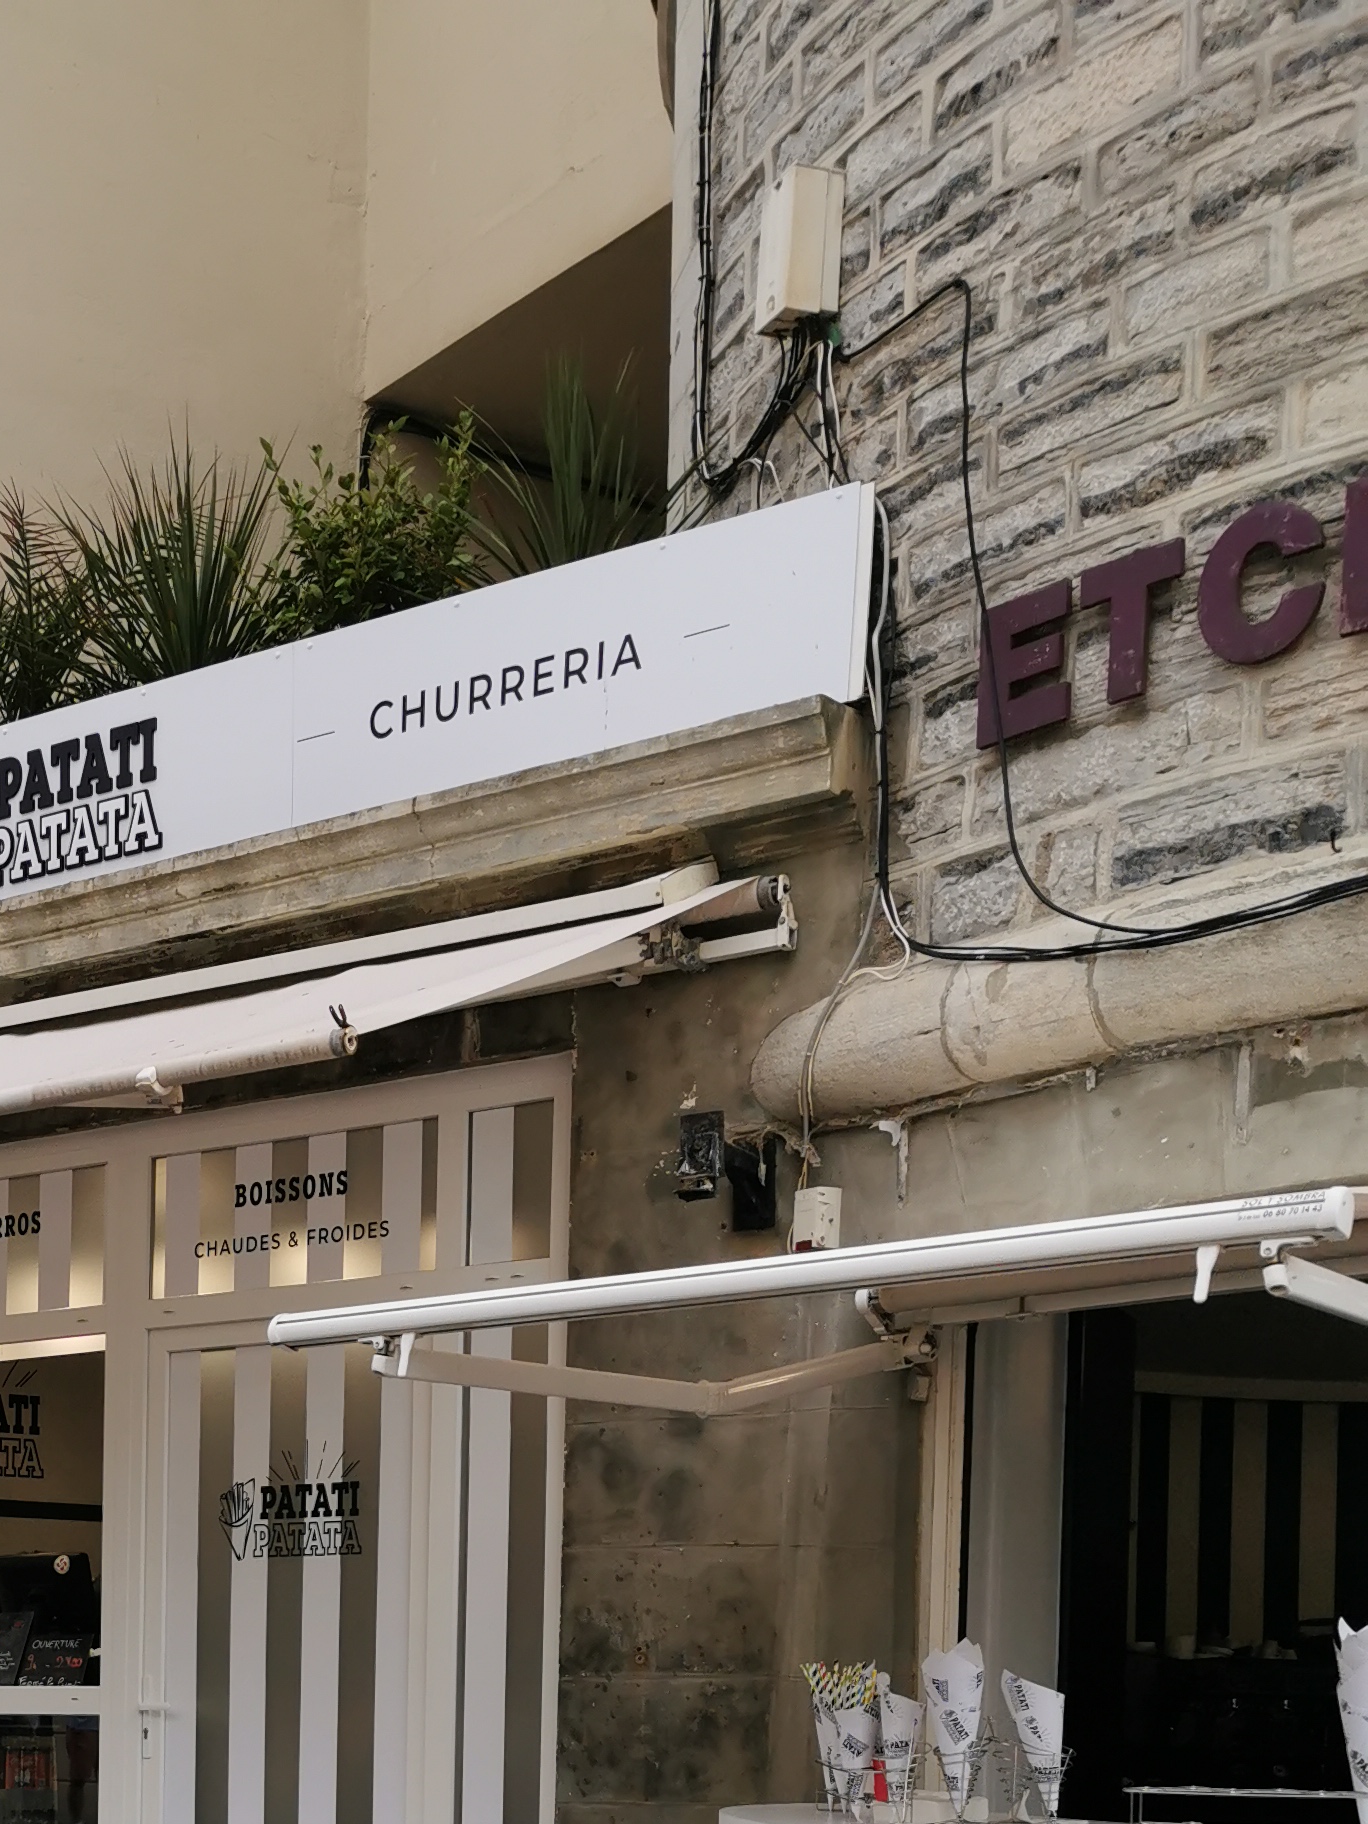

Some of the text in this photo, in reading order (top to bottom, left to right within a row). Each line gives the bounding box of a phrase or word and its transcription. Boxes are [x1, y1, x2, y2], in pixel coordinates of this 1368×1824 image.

[368, 633, 643, 740] CHURRERIA
[234, 1170, 348, 1208] BOISSONS
[194, 1220, 390, 1259] CHAUDES & FROIDES
[260, 1481, 360, 1519] PATATI
[253, 1520, 362, 1557] PATATA
[32, 1638, 82, 1650] OUVERTURE
[1014, 1685, 1030, 1712] PATATI
[949, 1717, 970, 1741] PATATI
